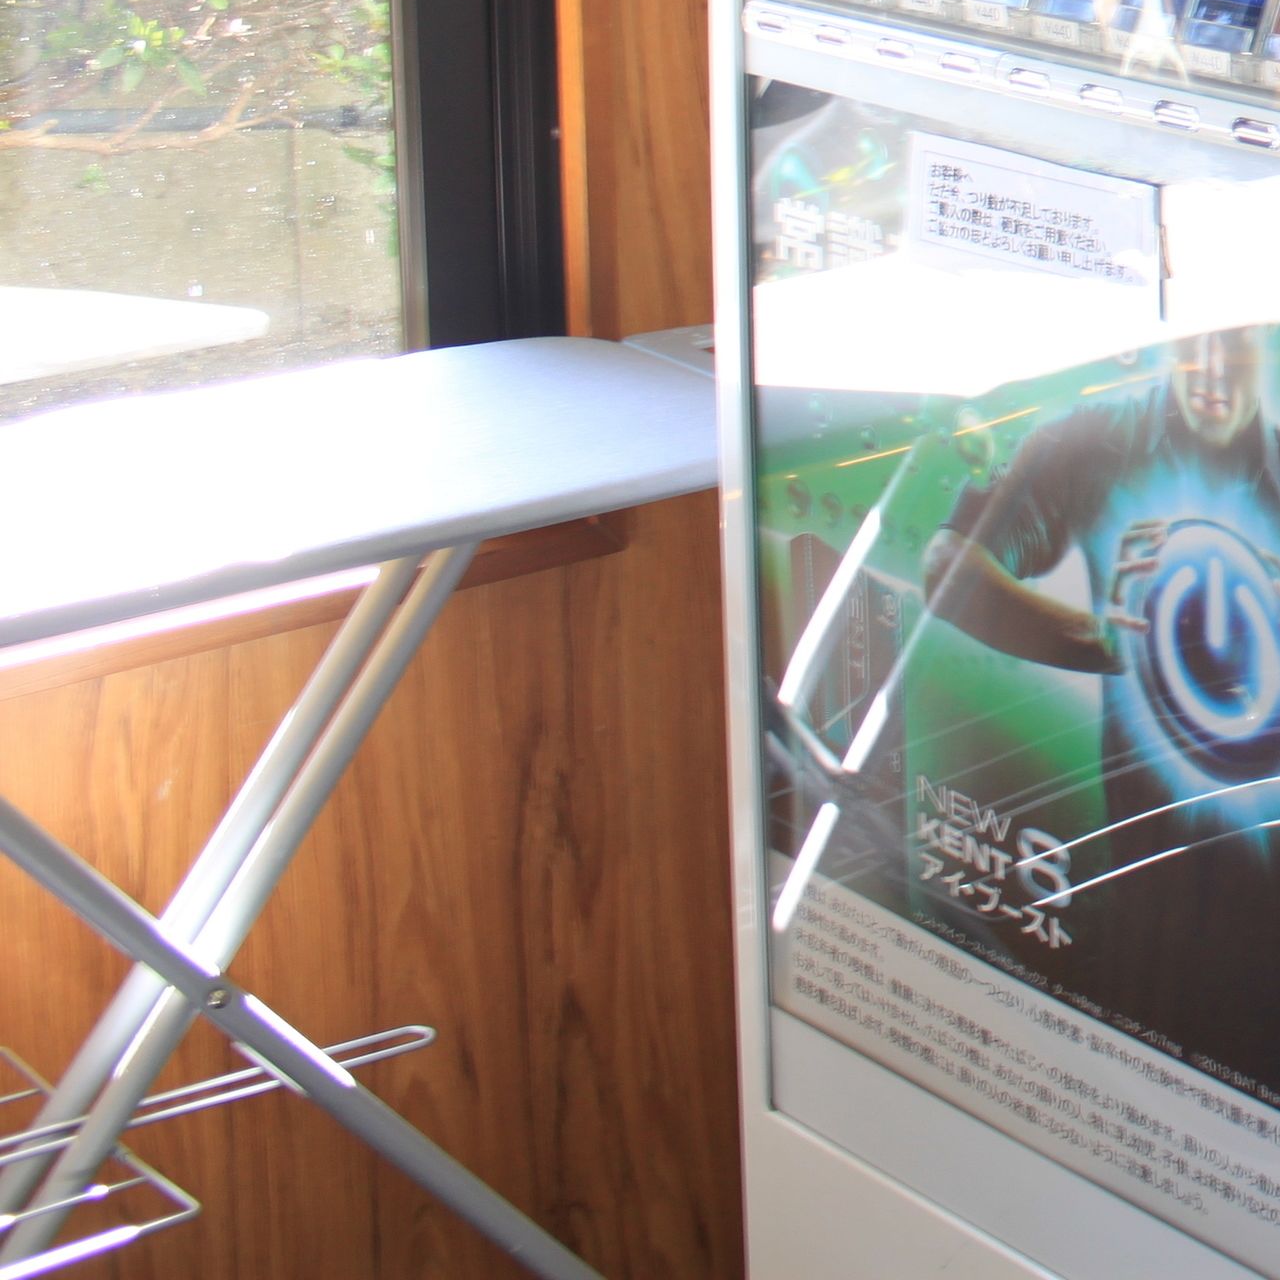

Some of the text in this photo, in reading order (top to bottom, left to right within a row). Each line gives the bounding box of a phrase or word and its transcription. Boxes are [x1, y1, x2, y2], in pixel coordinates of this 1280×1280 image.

[916, 774, 1012, 842] NEW
[917, 811, 1074, 909] KENT 8
